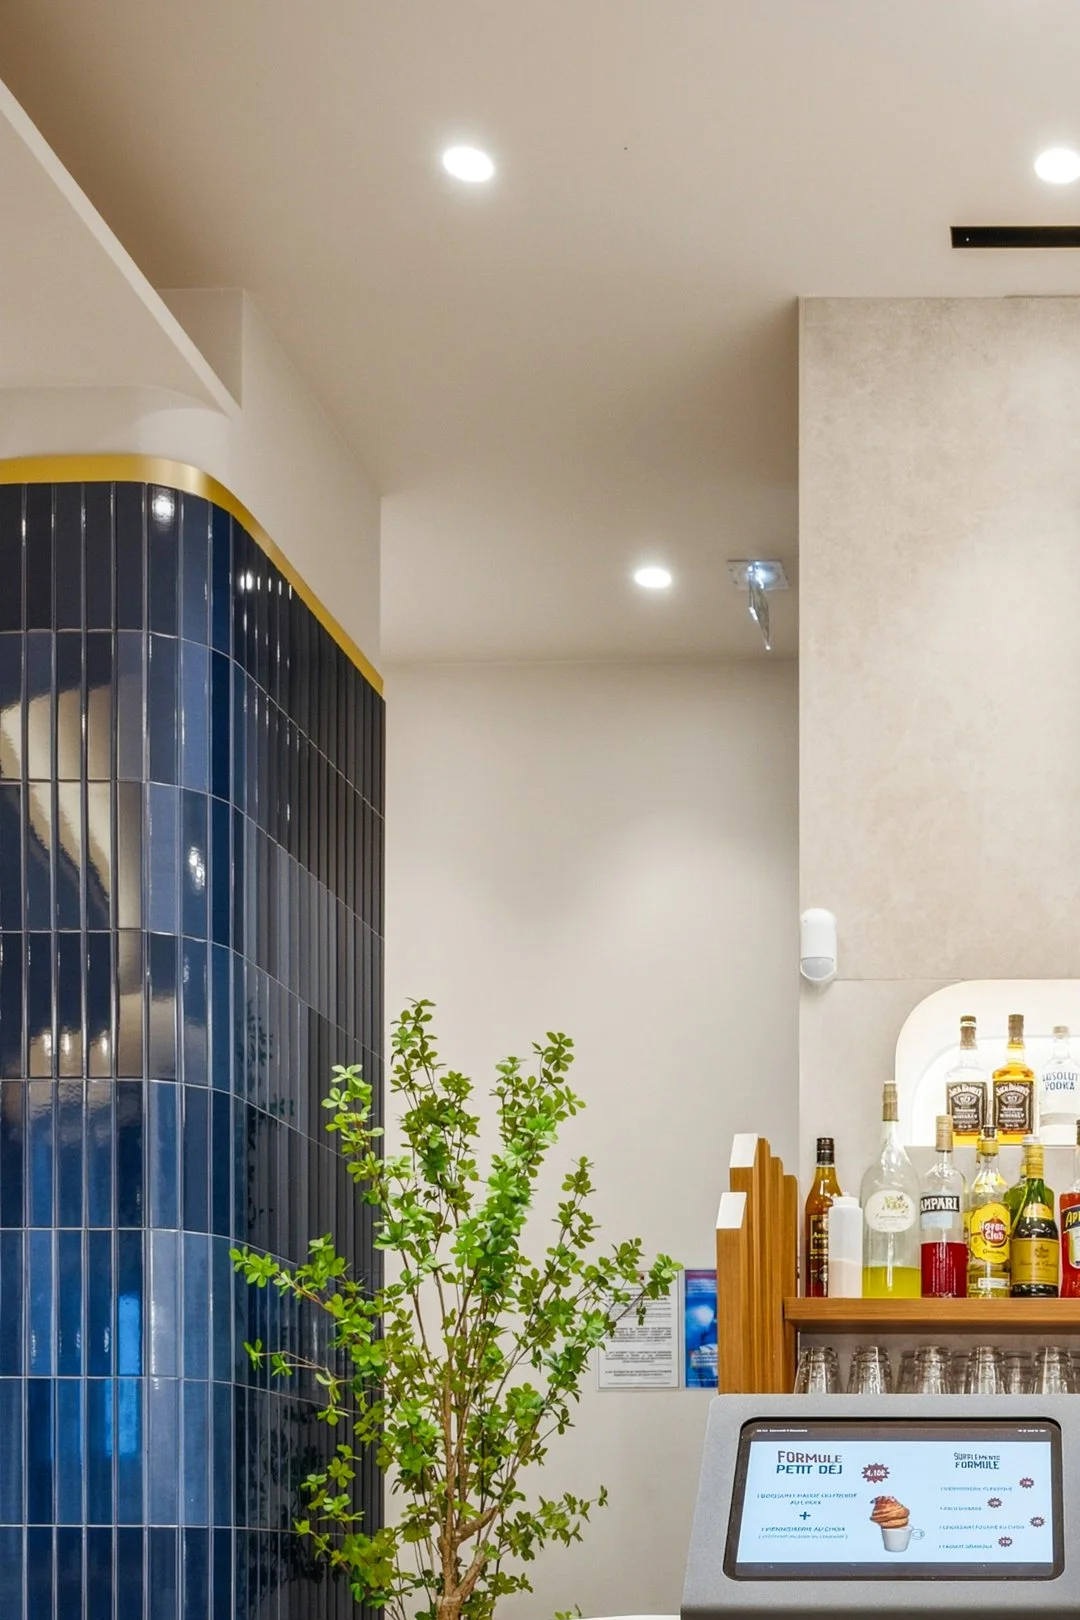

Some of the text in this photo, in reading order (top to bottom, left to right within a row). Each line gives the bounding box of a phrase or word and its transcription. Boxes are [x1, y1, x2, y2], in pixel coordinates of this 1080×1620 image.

[1045, 1081, 1075, 1091] VODKA
[778, 1450, 842, 1464] FORMULE
[776, 1462, 842, 1475] PETIT DÉJ
[955, 1461, 1000, 1469] FORMULE
